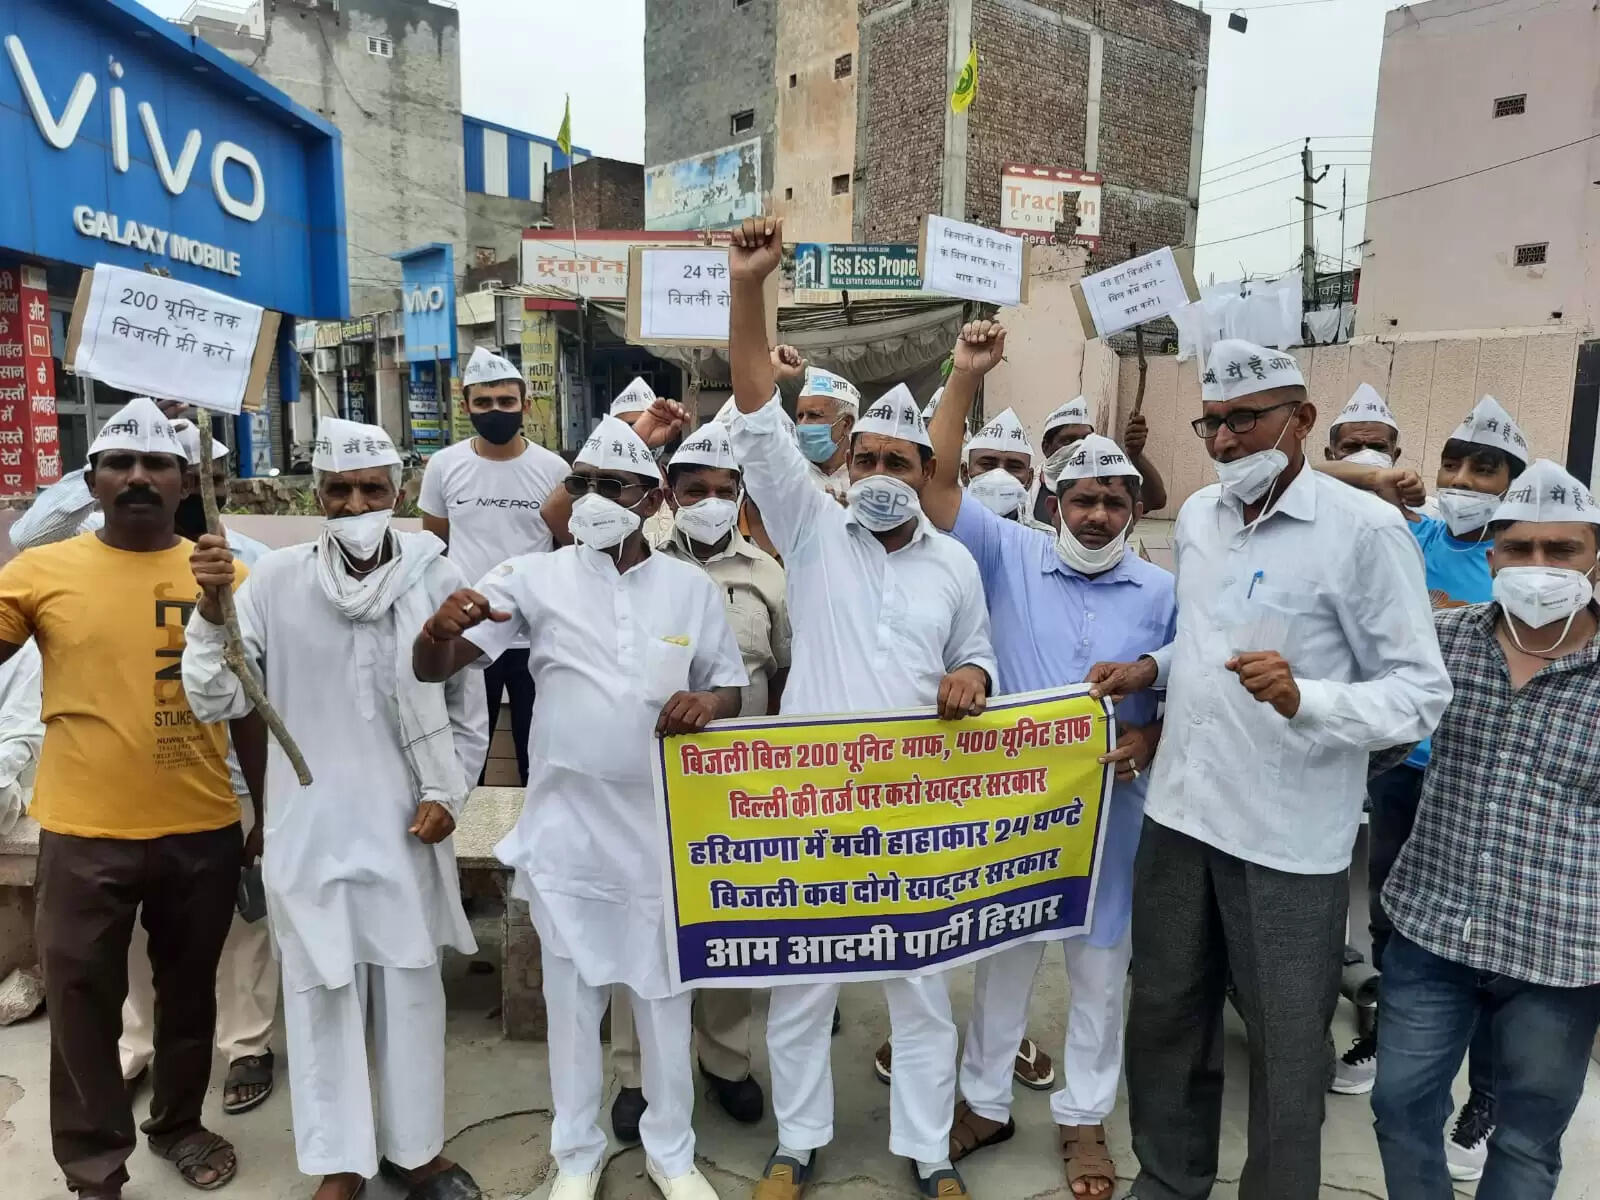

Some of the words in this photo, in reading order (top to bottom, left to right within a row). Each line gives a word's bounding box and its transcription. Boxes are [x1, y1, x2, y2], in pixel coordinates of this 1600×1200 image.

[5, 35, 265, 222] vivo
[73, 205, 169, 255] GALAXY
[170, 234, 241, 276] MOBILE
[683, 265, 701, 279] 24
[707, 263, 728, 280] घंटे
[830, 254, 852, 275] Ess
[854, 255, 876, 277] Ess
[29, 295, 45, 321] और
[121, 288, 158, 310] 200
[165, 299, 209, 322] यूनिट
[214, 311, 241, 329] तक
[403, 282, 443, 312] vivo
[668, 289, 711, 306] बिजली
[112, 316, 171, 347] बिजली
[176, 333, 198, 354] फ्री
[203, 341, 235, 362] करो
[832, 380, 848, 392] आम
[1, 405, 14, 422] में
[904, 405, 915, 424] मैं
[1100, 454, 1125, 465] आम
[4, 474, 22, 486] पर
[476, 498, 508, 508] NIKE
[509, 500, 540, 509] PRO
[861, 485, 909, 515] aap
[681, 741, 749, 774] बिजली
[752, 740, 792, 769] बिल
[797, 743, 838, 768] 200
[844, 734, 895, 773] यूनिट
[902, 735, 951, 761] माफ,
[957, 730, 997, 753] 400
[1002, 717, 1050, 757] यूनिट
[1055, 715, 1092, 743] हाफ
[729, 787, 788, 818] दिल्ली
[791, 784, 818, 816] की
[821, 780, 854, 813] तर्ज
[857, 783, 881, 809] पर
[885, 775, 922, 806] करो
[925, 775, 983, 807] खट्टर
[987, 767, 1048, 796] सरकार
[688, 835, 800, 864] हरियाणा
[804, 829, 829, 859] में
[831, 826, 882, 857] मची
[886, 821, 989, 855] हाहाकार
[994, 817, 1029, 843] 24
[1032, 797, 1083, 831] घण्टे
[710, 878, 799, 909] बिजली
[803, 881, 849, 906] कब
[852, 872, 901, 903] दोगे
[905, 867, 982, 900] खट्टर
[985, 847, 1061, 884] सरकार
[705, 937, 780, 967] आम
[788, 924, 899, 964] आदमी
[903, 907, 974, 959] पार्टी
[977, 894, 1063, 941] हिसार
